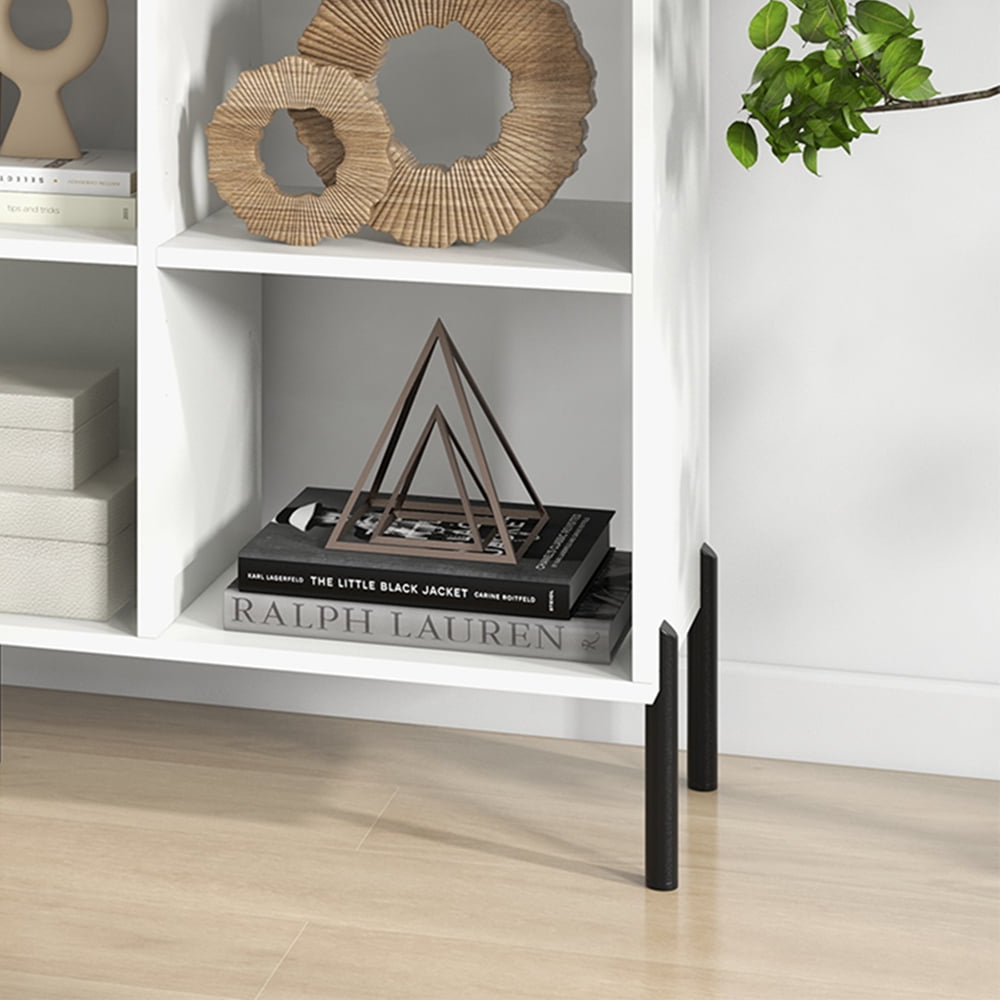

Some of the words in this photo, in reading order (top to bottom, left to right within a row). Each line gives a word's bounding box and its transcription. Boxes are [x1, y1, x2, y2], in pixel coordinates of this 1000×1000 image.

[23, 204, 40, 213] and
[41, 204, 61, 214] tricks
[247, 572, 265, 581] KARL
[266, 574, 304, 584] LAGERFELD
[310, 575, 334, 588] THE
[337, 578, 376, 591] LITTLE
[380, 581, 418, 595] BLACK
[422, 584, 468, 599] JACKET
[473, 591, 500, 601] CARINE
[231, 596, 374, 635] RALPH
[391, 610, 565, 651] LAUREN
